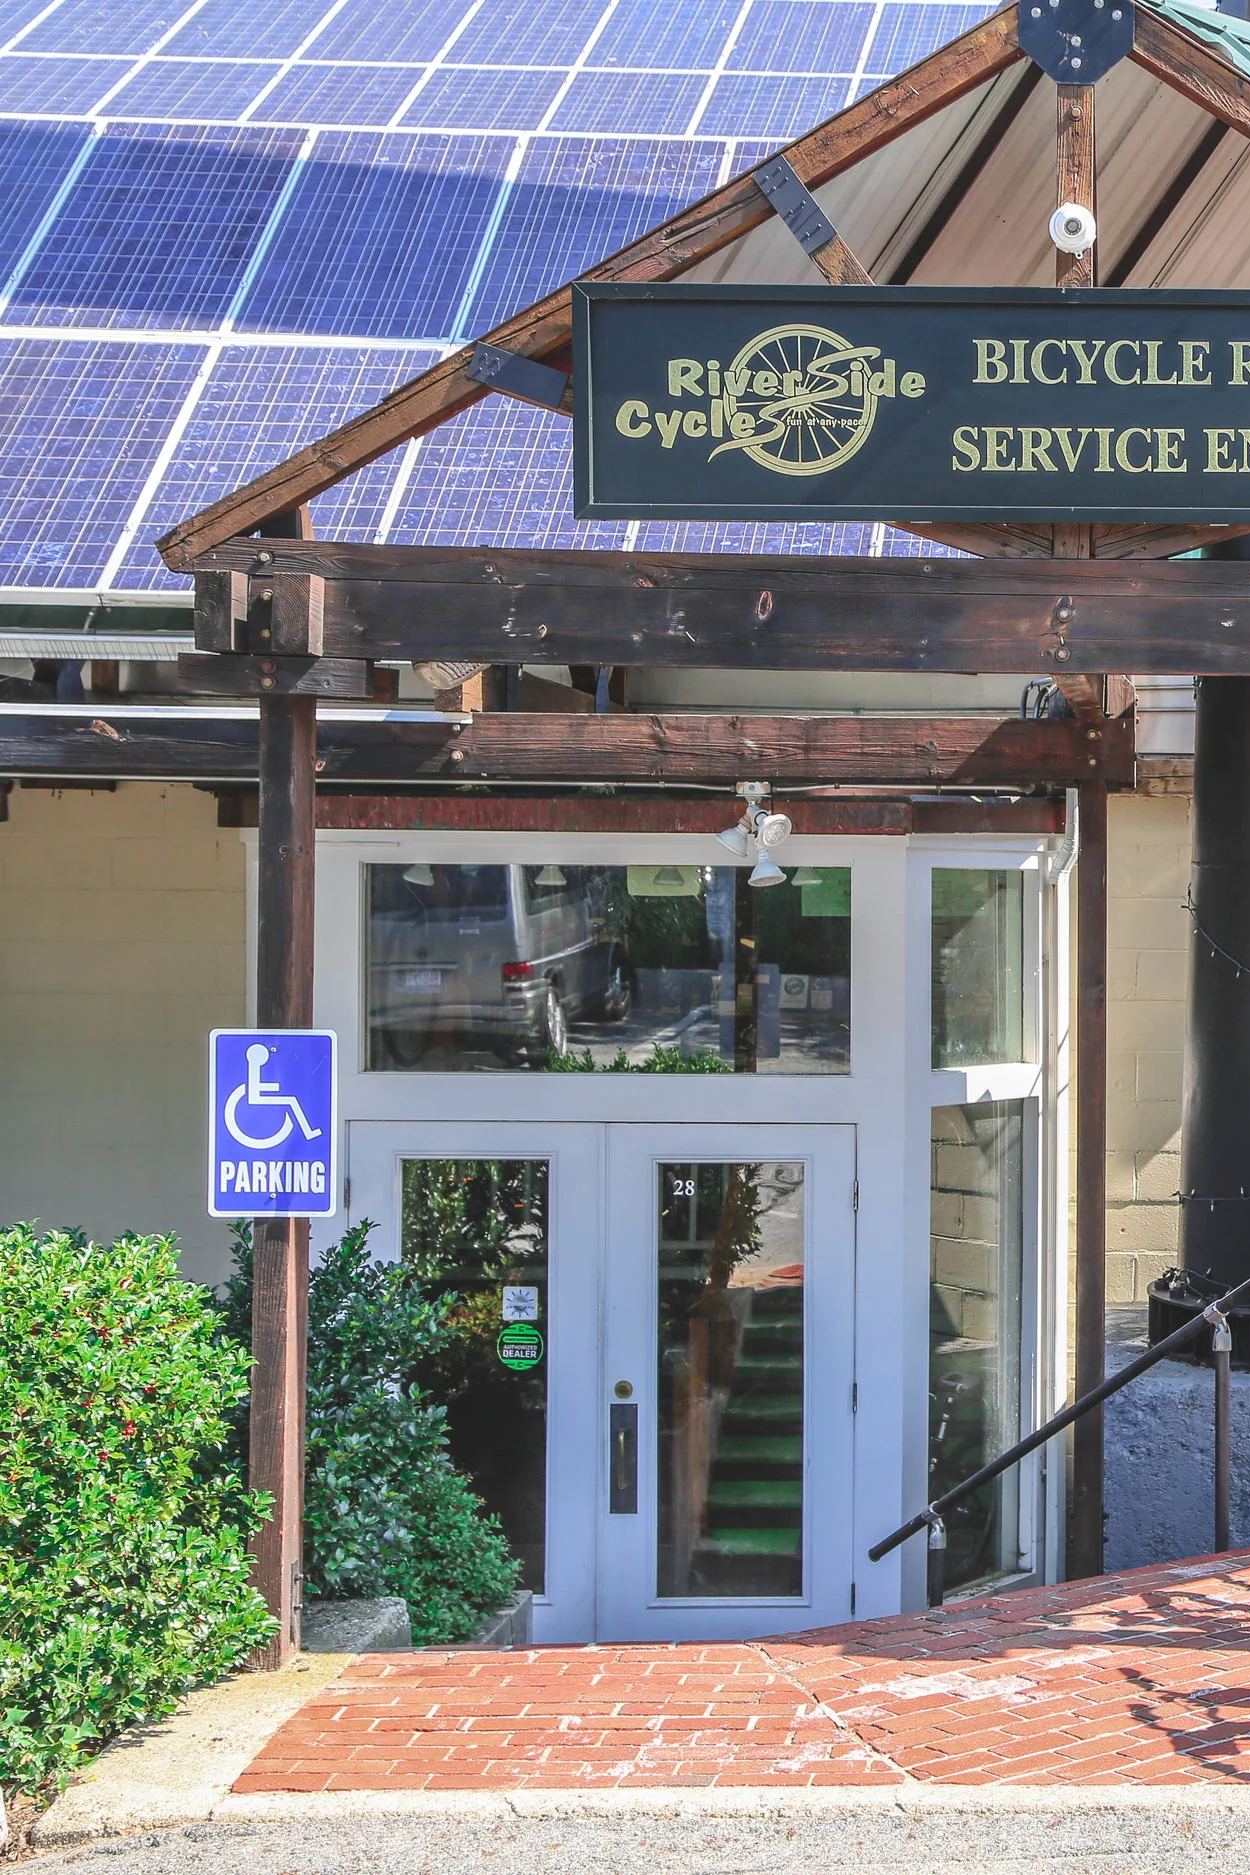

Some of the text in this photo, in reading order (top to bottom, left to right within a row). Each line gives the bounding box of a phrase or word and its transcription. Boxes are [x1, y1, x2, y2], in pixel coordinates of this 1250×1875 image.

[972, 339, 1212, 385] BICYCLE
[786, 416, 802, 426] fun
[806, 417, 817, 426] at
[820, 418, 837, 428] any
[952, 426, 1188, 473] SERVICE
[220, 1161, 325, 1193] PARKING
[673, 1180, 695, 1195] 28
[502, 1350, 537, 1358] DEALER
